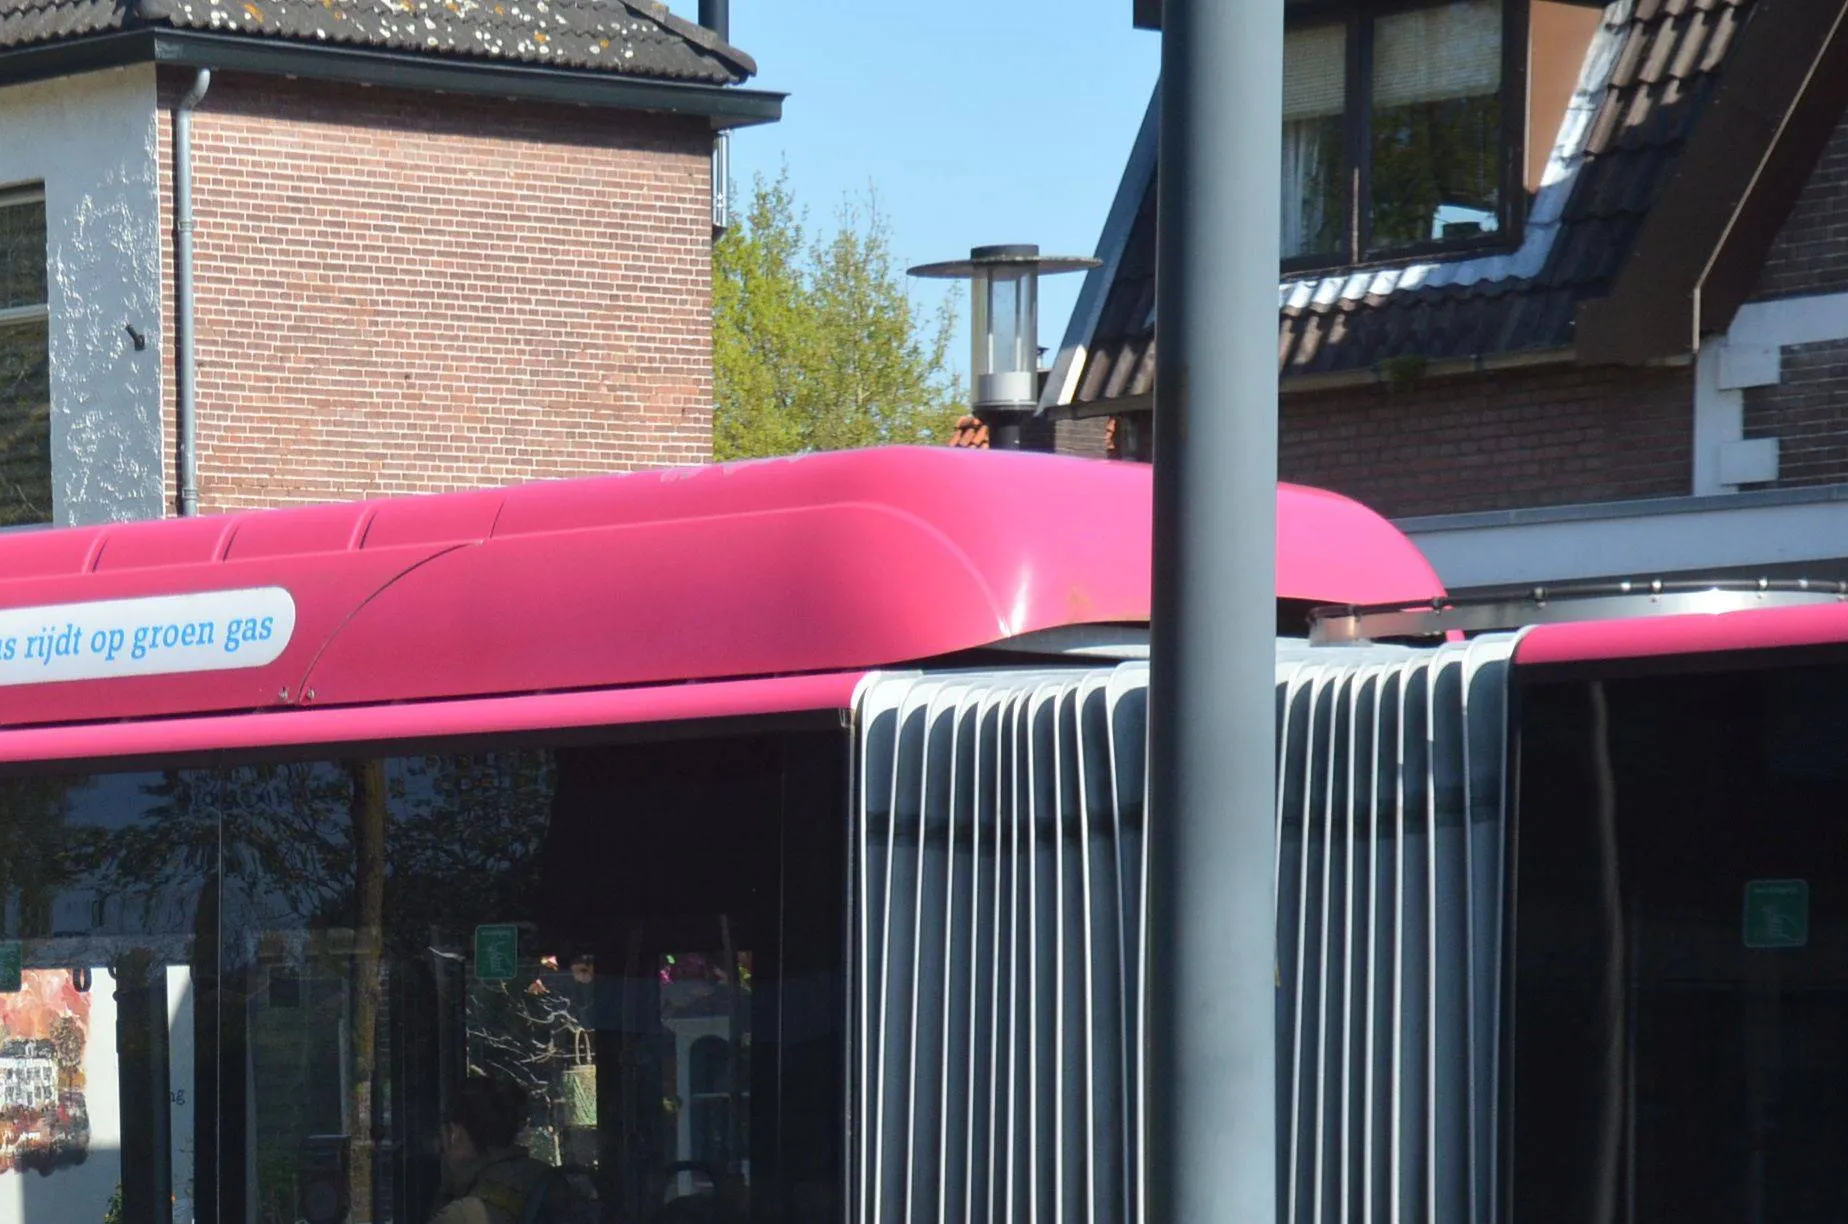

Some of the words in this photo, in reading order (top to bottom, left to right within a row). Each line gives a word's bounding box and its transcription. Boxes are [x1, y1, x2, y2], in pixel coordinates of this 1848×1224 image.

[23, 624, 83, 667] rijdt
[90, 628, 126, 662] op
[131, 621, 216, 660] groen
[223, 614, 275, 652] gas
